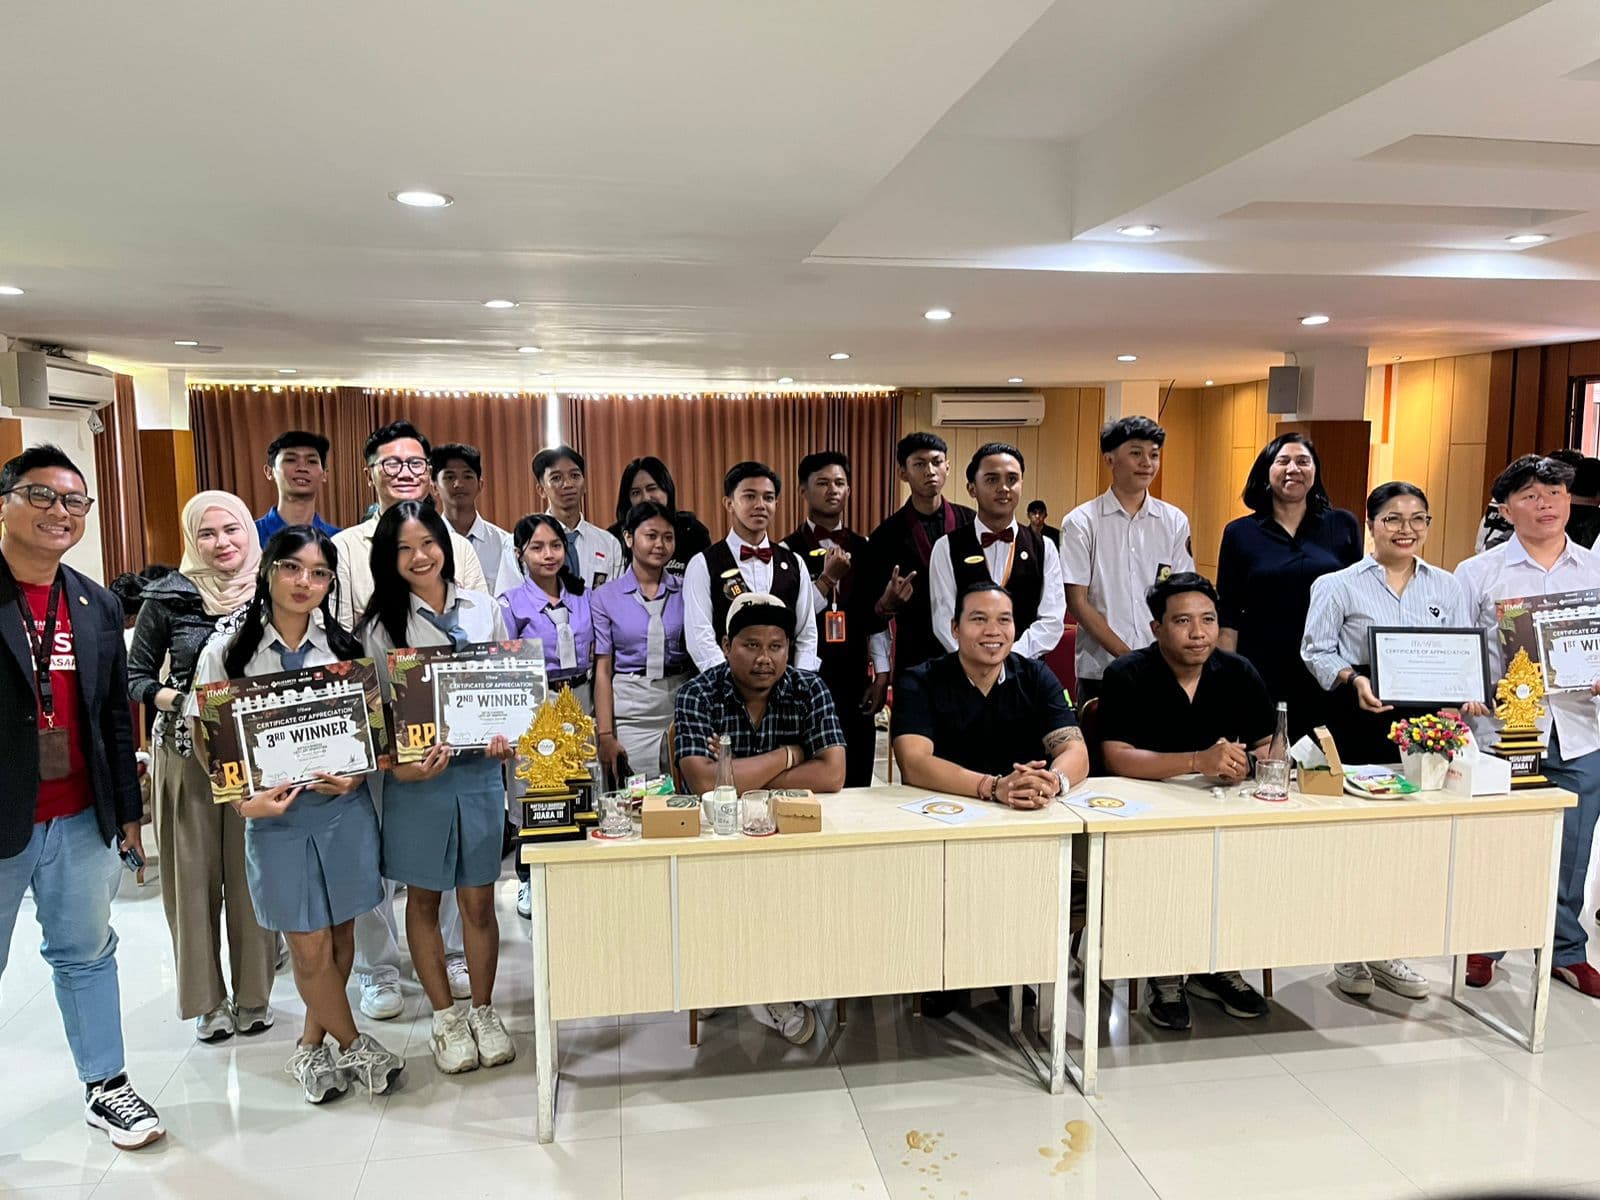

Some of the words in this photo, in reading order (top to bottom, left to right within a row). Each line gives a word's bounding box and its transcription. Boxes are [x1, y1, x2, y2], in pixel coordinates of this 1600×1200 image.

[477, 694, 528, 707] WINNER
[256, 716, 297, 730] CERTIFICATE
[298, 714, 307, 722] OF
[308, 707, 353, 720] APPRECIATION
[289, 720, 349, 743] WINNER
[532, 811, 555, 820] JUARA
